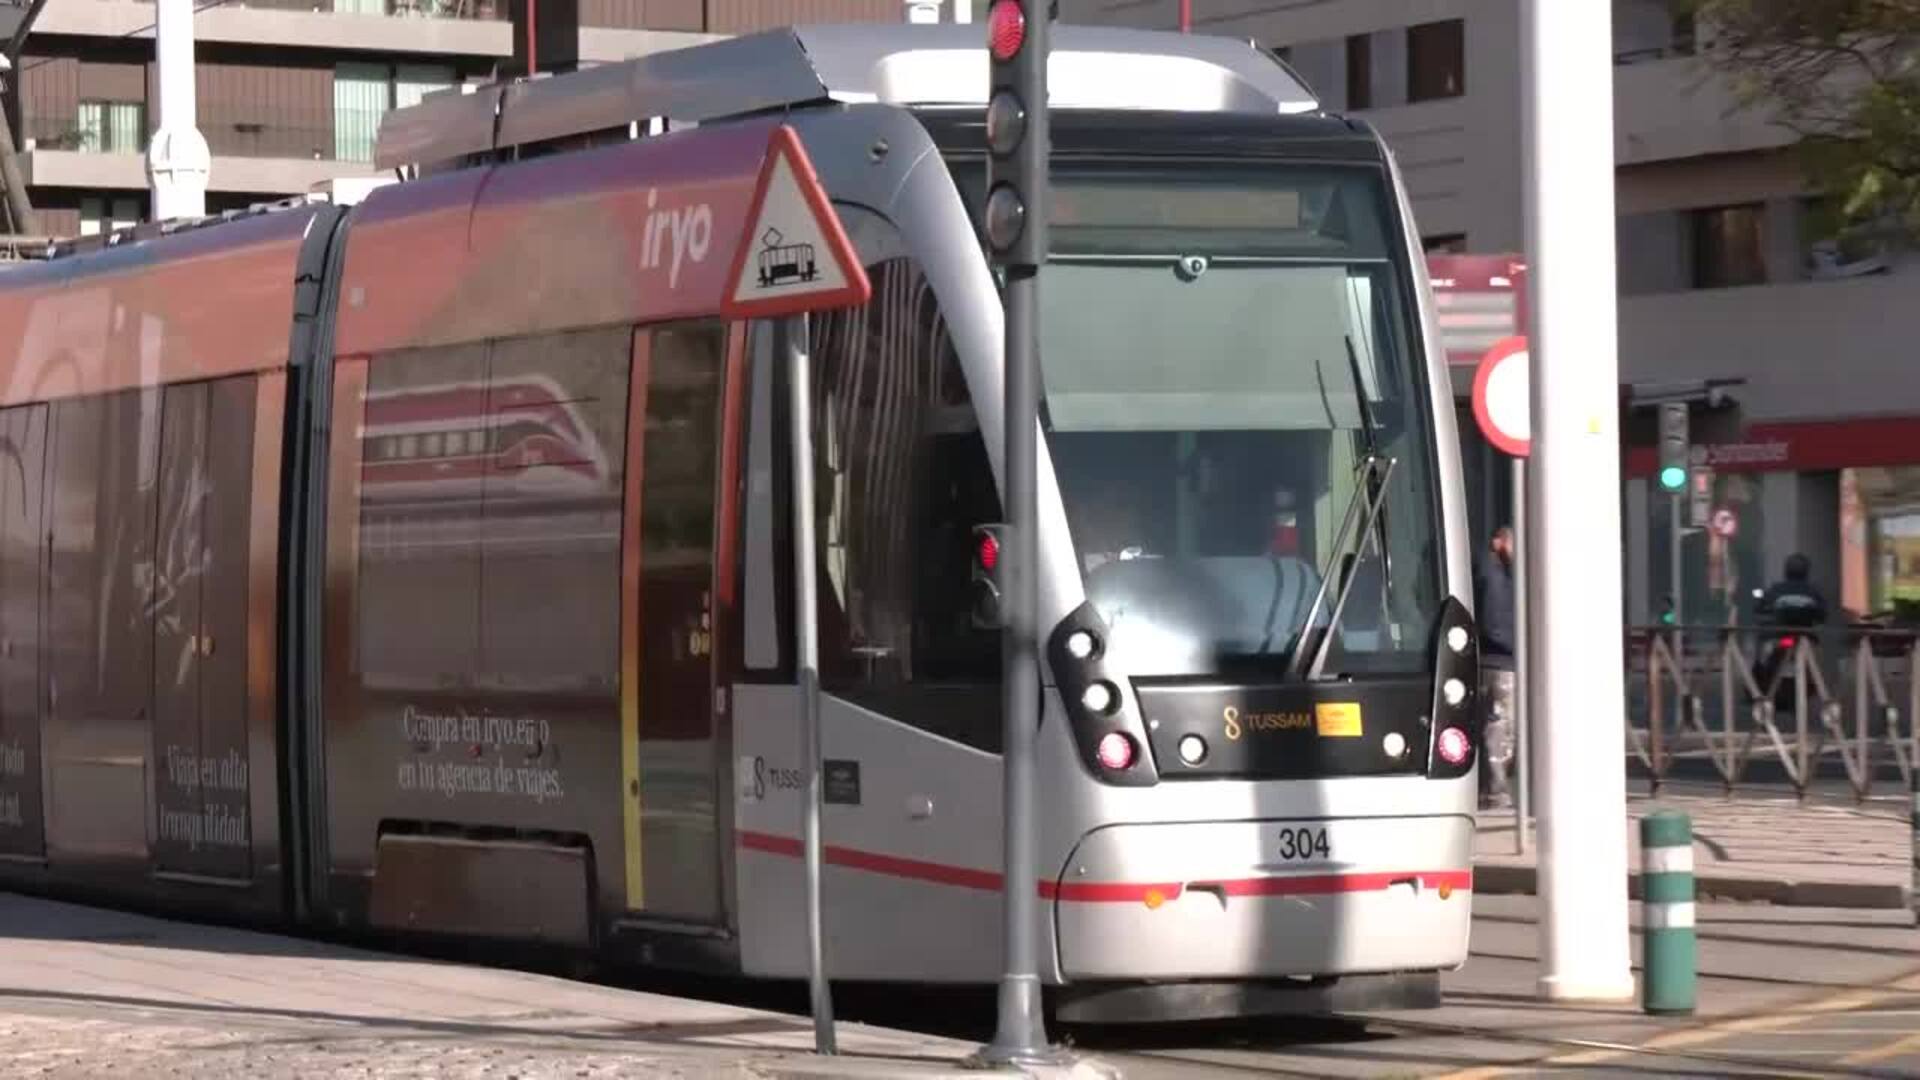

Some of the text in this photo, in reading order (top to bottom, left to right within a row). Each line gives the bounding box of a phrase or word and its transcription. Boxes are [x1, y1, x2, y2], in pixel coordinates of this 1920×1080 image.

[640, 188, 711, 288] iryo
[403, 705, 460, 751] Compra
[462, 714, 480, 743] en
[1248, 712, 1312, 731] TUSSAM
[398, 763, 416, 790] en
[438, 762, 493, 798] agencia
[494, 755, 514, 793] de
[1279, 827, 1331, 859] 304
